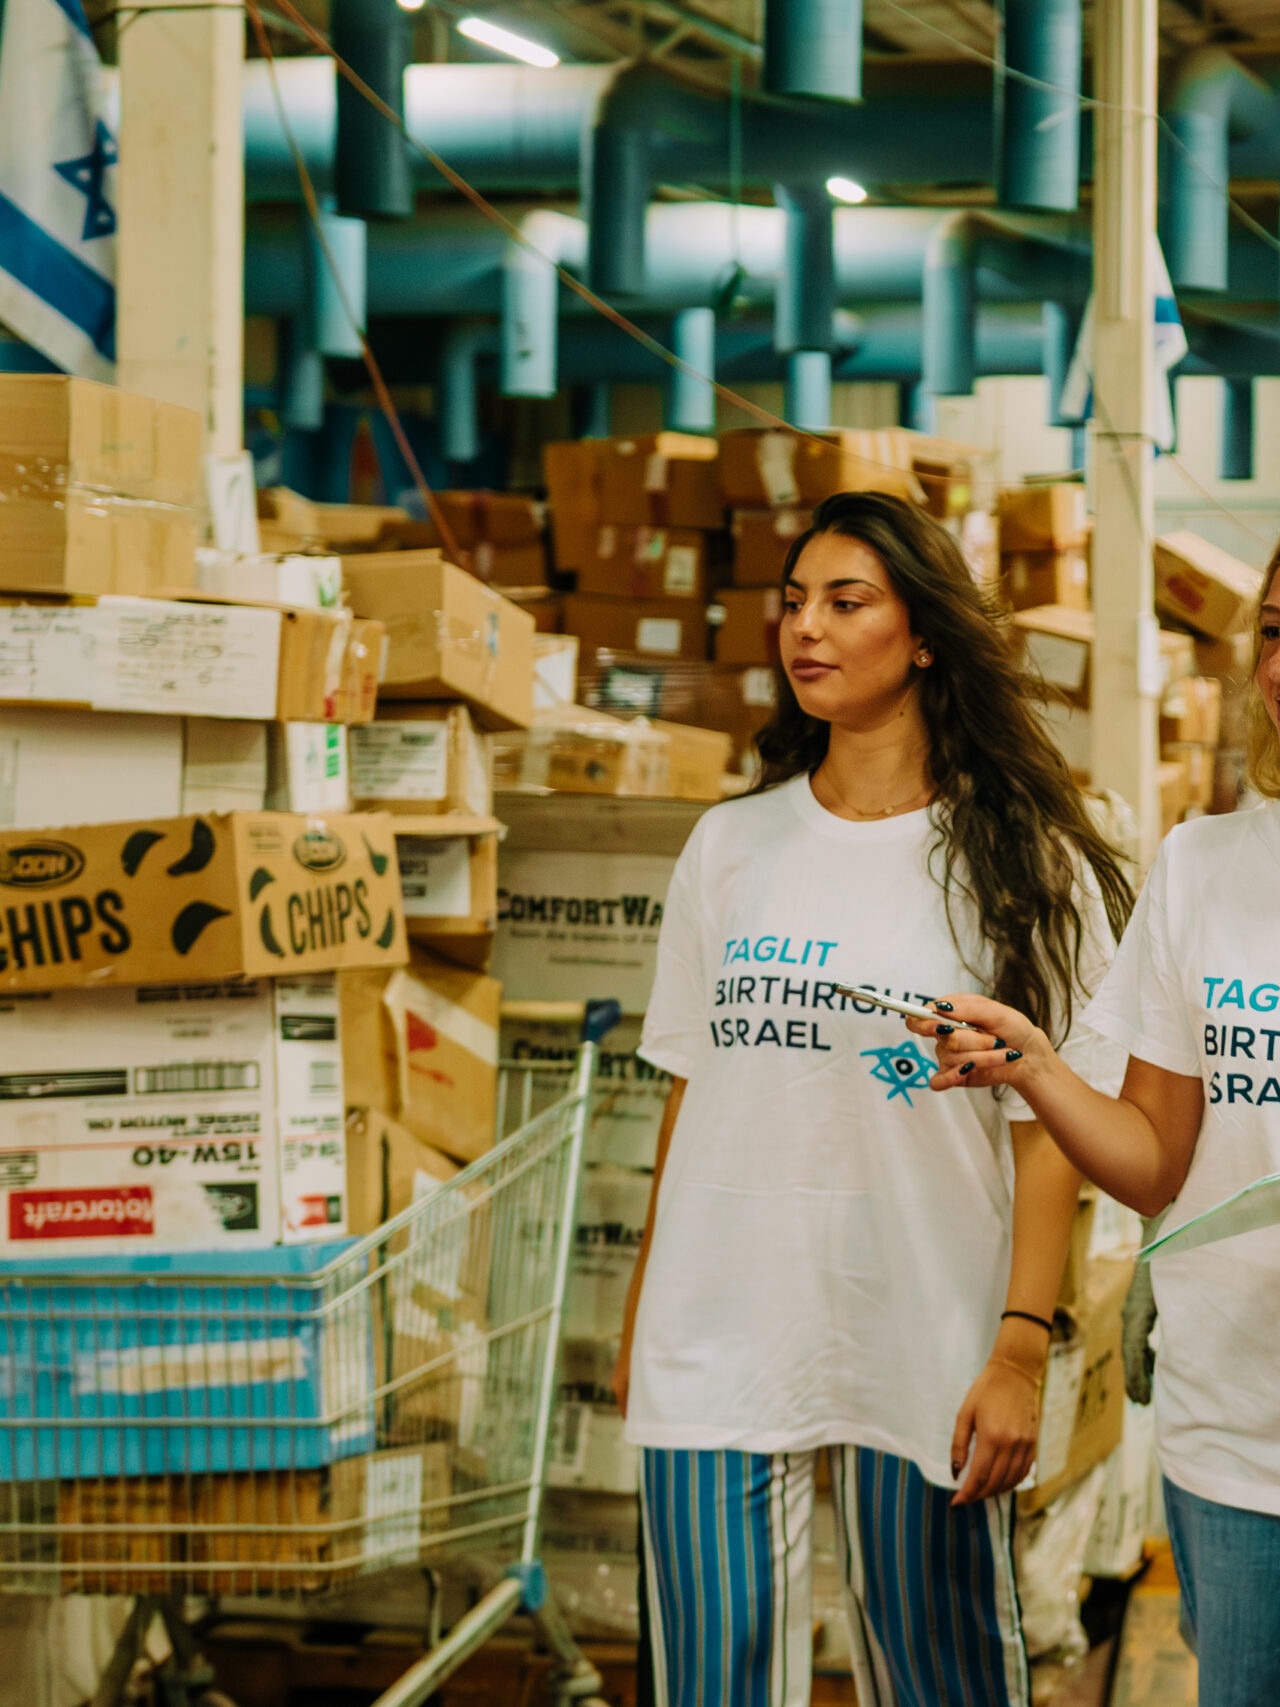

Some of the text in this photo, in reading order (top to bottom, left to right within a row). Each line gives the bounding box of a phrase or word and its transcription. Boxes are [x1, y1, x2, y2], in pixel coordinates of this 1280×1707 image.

[287, 877, 372, 956] CHIPS
[722, 935, 839, 967] TAGLIT
[710, 1017, 832, 1051] ISRAEL
[132, 1141, 258, 1167] 15W-40
